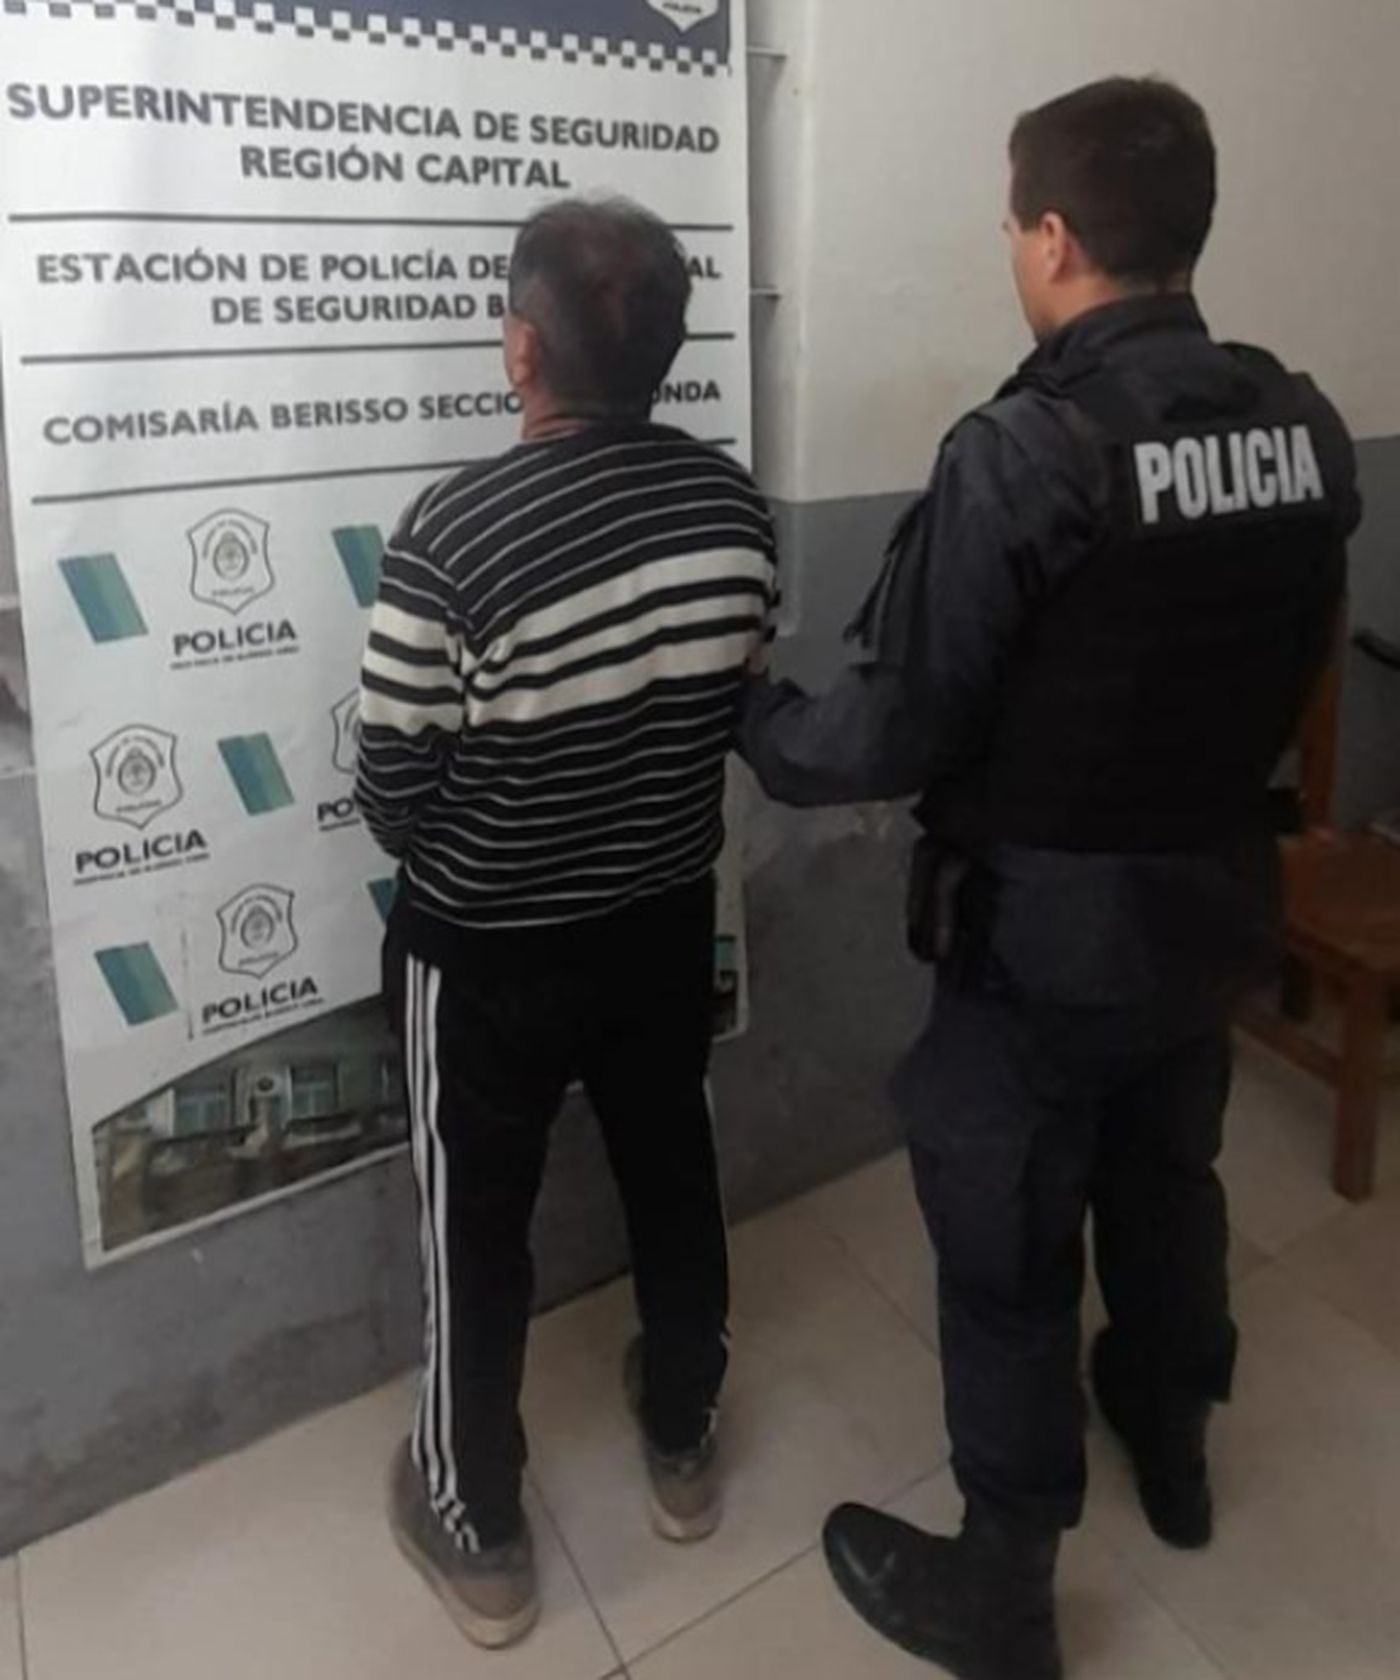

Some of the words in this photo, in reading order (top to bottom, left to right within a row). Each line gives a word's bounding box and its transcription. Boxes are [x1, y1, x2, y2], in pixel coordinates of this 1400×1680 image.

[6, 83, 461, 138] SUPERINTENDENCIA
[474, 110, 519, 142] DE
[530, 115, 720, 154] SEGURIDAD
[240, 144, 404, 182] REGIÓN
[417, 153, 570, 188] CAPITAL
[37, 247, 247, 283] ESTACIÓN
[261, 253, 309, 282] DE
[321, 249, 457, 281] POLICÍA
[211, 296, 262, 324] DE
[274, 294, 477, 323] SEGURIDAD
[43, 400, 259, 445] COMISARÍA
[271, 397, 409, 429] BERISSO
[1133, 424, 1324, 524] POLICIA
[173, 619, 297, 656] POLICIA
[75, 829, 207, 874] POLICIA
